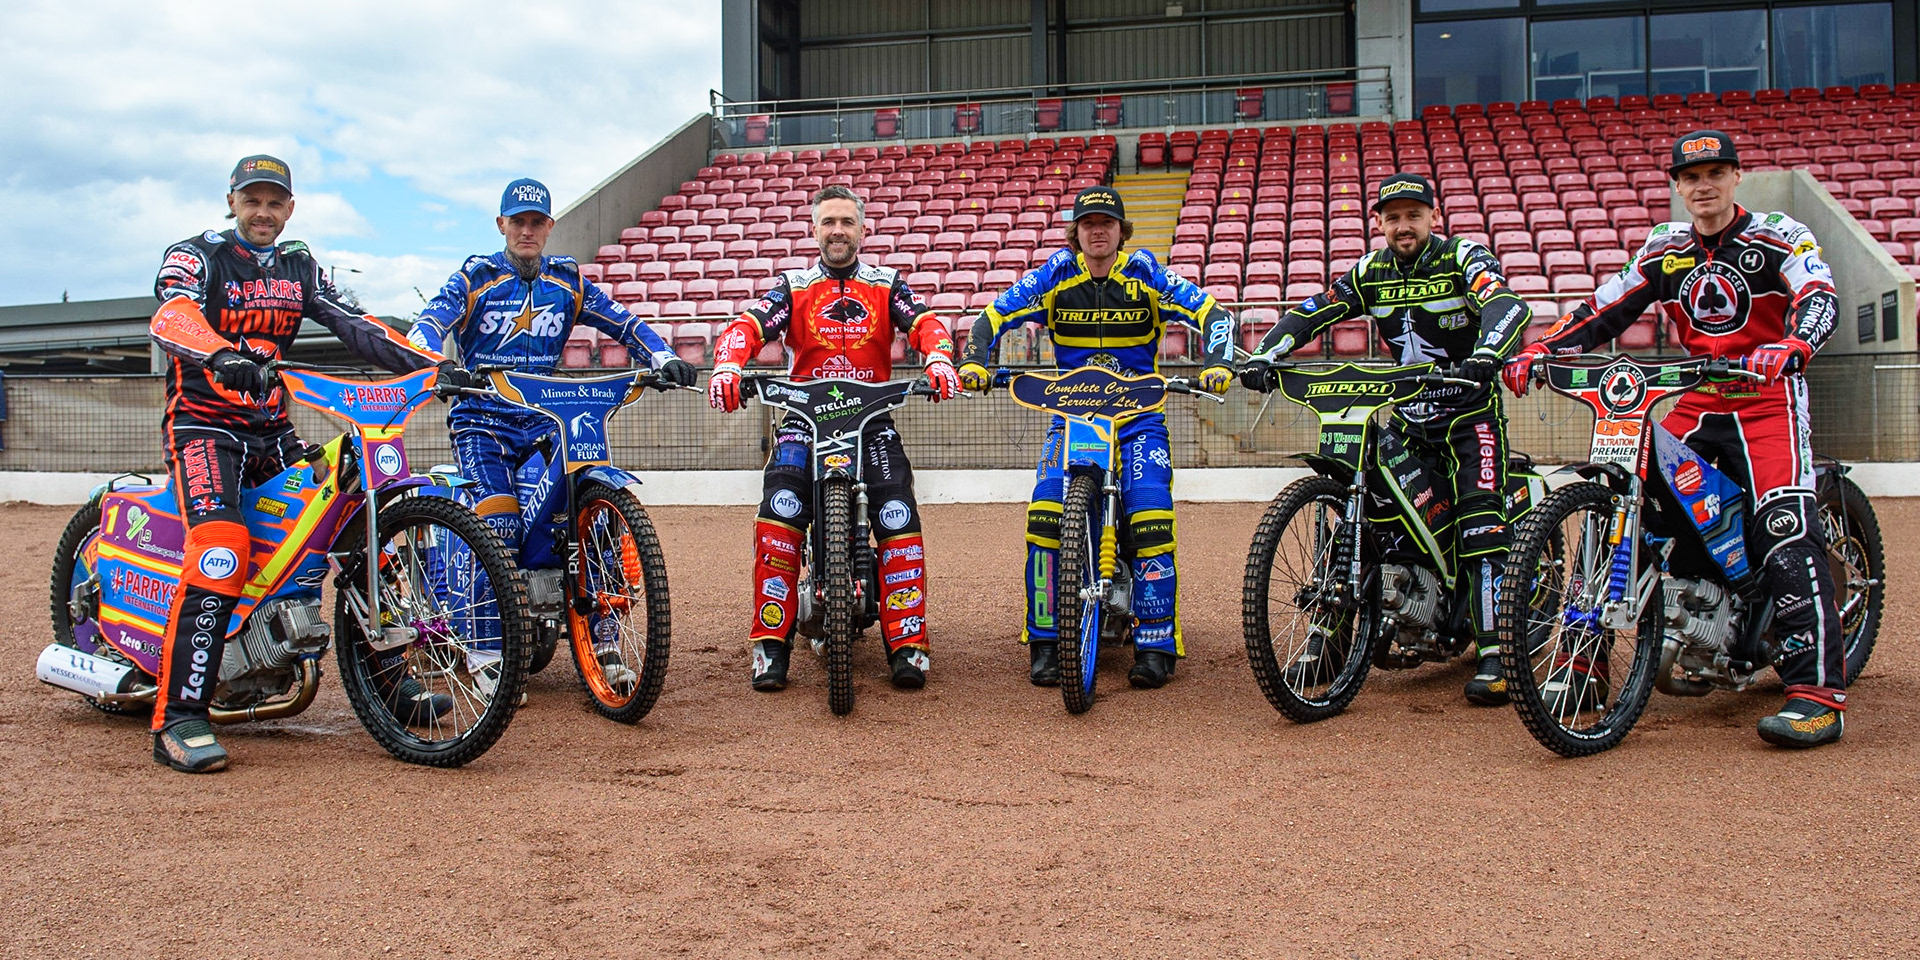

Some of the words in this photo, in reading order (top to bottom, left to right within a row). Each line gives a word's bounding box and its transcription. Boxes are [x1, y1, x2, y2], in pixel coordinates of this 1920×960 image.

[512, 185, 546, 198] ADRIAN
[519, 193, 542, 203] FLUX
[170, 253, 200, 269] NGK
[1745, 254, 1758, 267] 4
[1125, 281, 1138, 300] 4
[1380, 288, 1396, 299] RU
[1398, 282, 1448, 298] PLANT
[1061, 311, 1089, 322] TRU
[1092, 309, 1145, 322] PLANT
[820, 326, 868, 334] PANTHERS
[541, 388, 577, 398] Minors
[578, 385, 590, 398] &
[592, 387, 616, 401] Brady
[1044, 382, 1100, 396] Complete
[1104, 381, 1130, 394] Car
[1311, 384, 1337, 395] TRU
[356, 387, 407, 404] PARRYS
[1057, 396, 1108, 408] Services
[814, 397, 863, 415] STELLAR
[816, 406, 863, 423] DESPATCH
[570, 443, 605, 451] ADRIAN
[1592, 447, 1638, 456] PREMIER
[380, 453, 397, 465] ATPI
[577, 451, 600, 459] FLUX
[183, 438, 213, 498] PARRYS
[776, 497, 797, 510] ATPI
[104, 504, 120, 535] 1
[884, 508, 905, 521] ATPI
[486, 518, 521, 529] DRIAN
[1771, 514, 1793, 530] ATPI
[206, 557, 231, 569] ATPI
[124, 569, 178, 606] PARRYS
